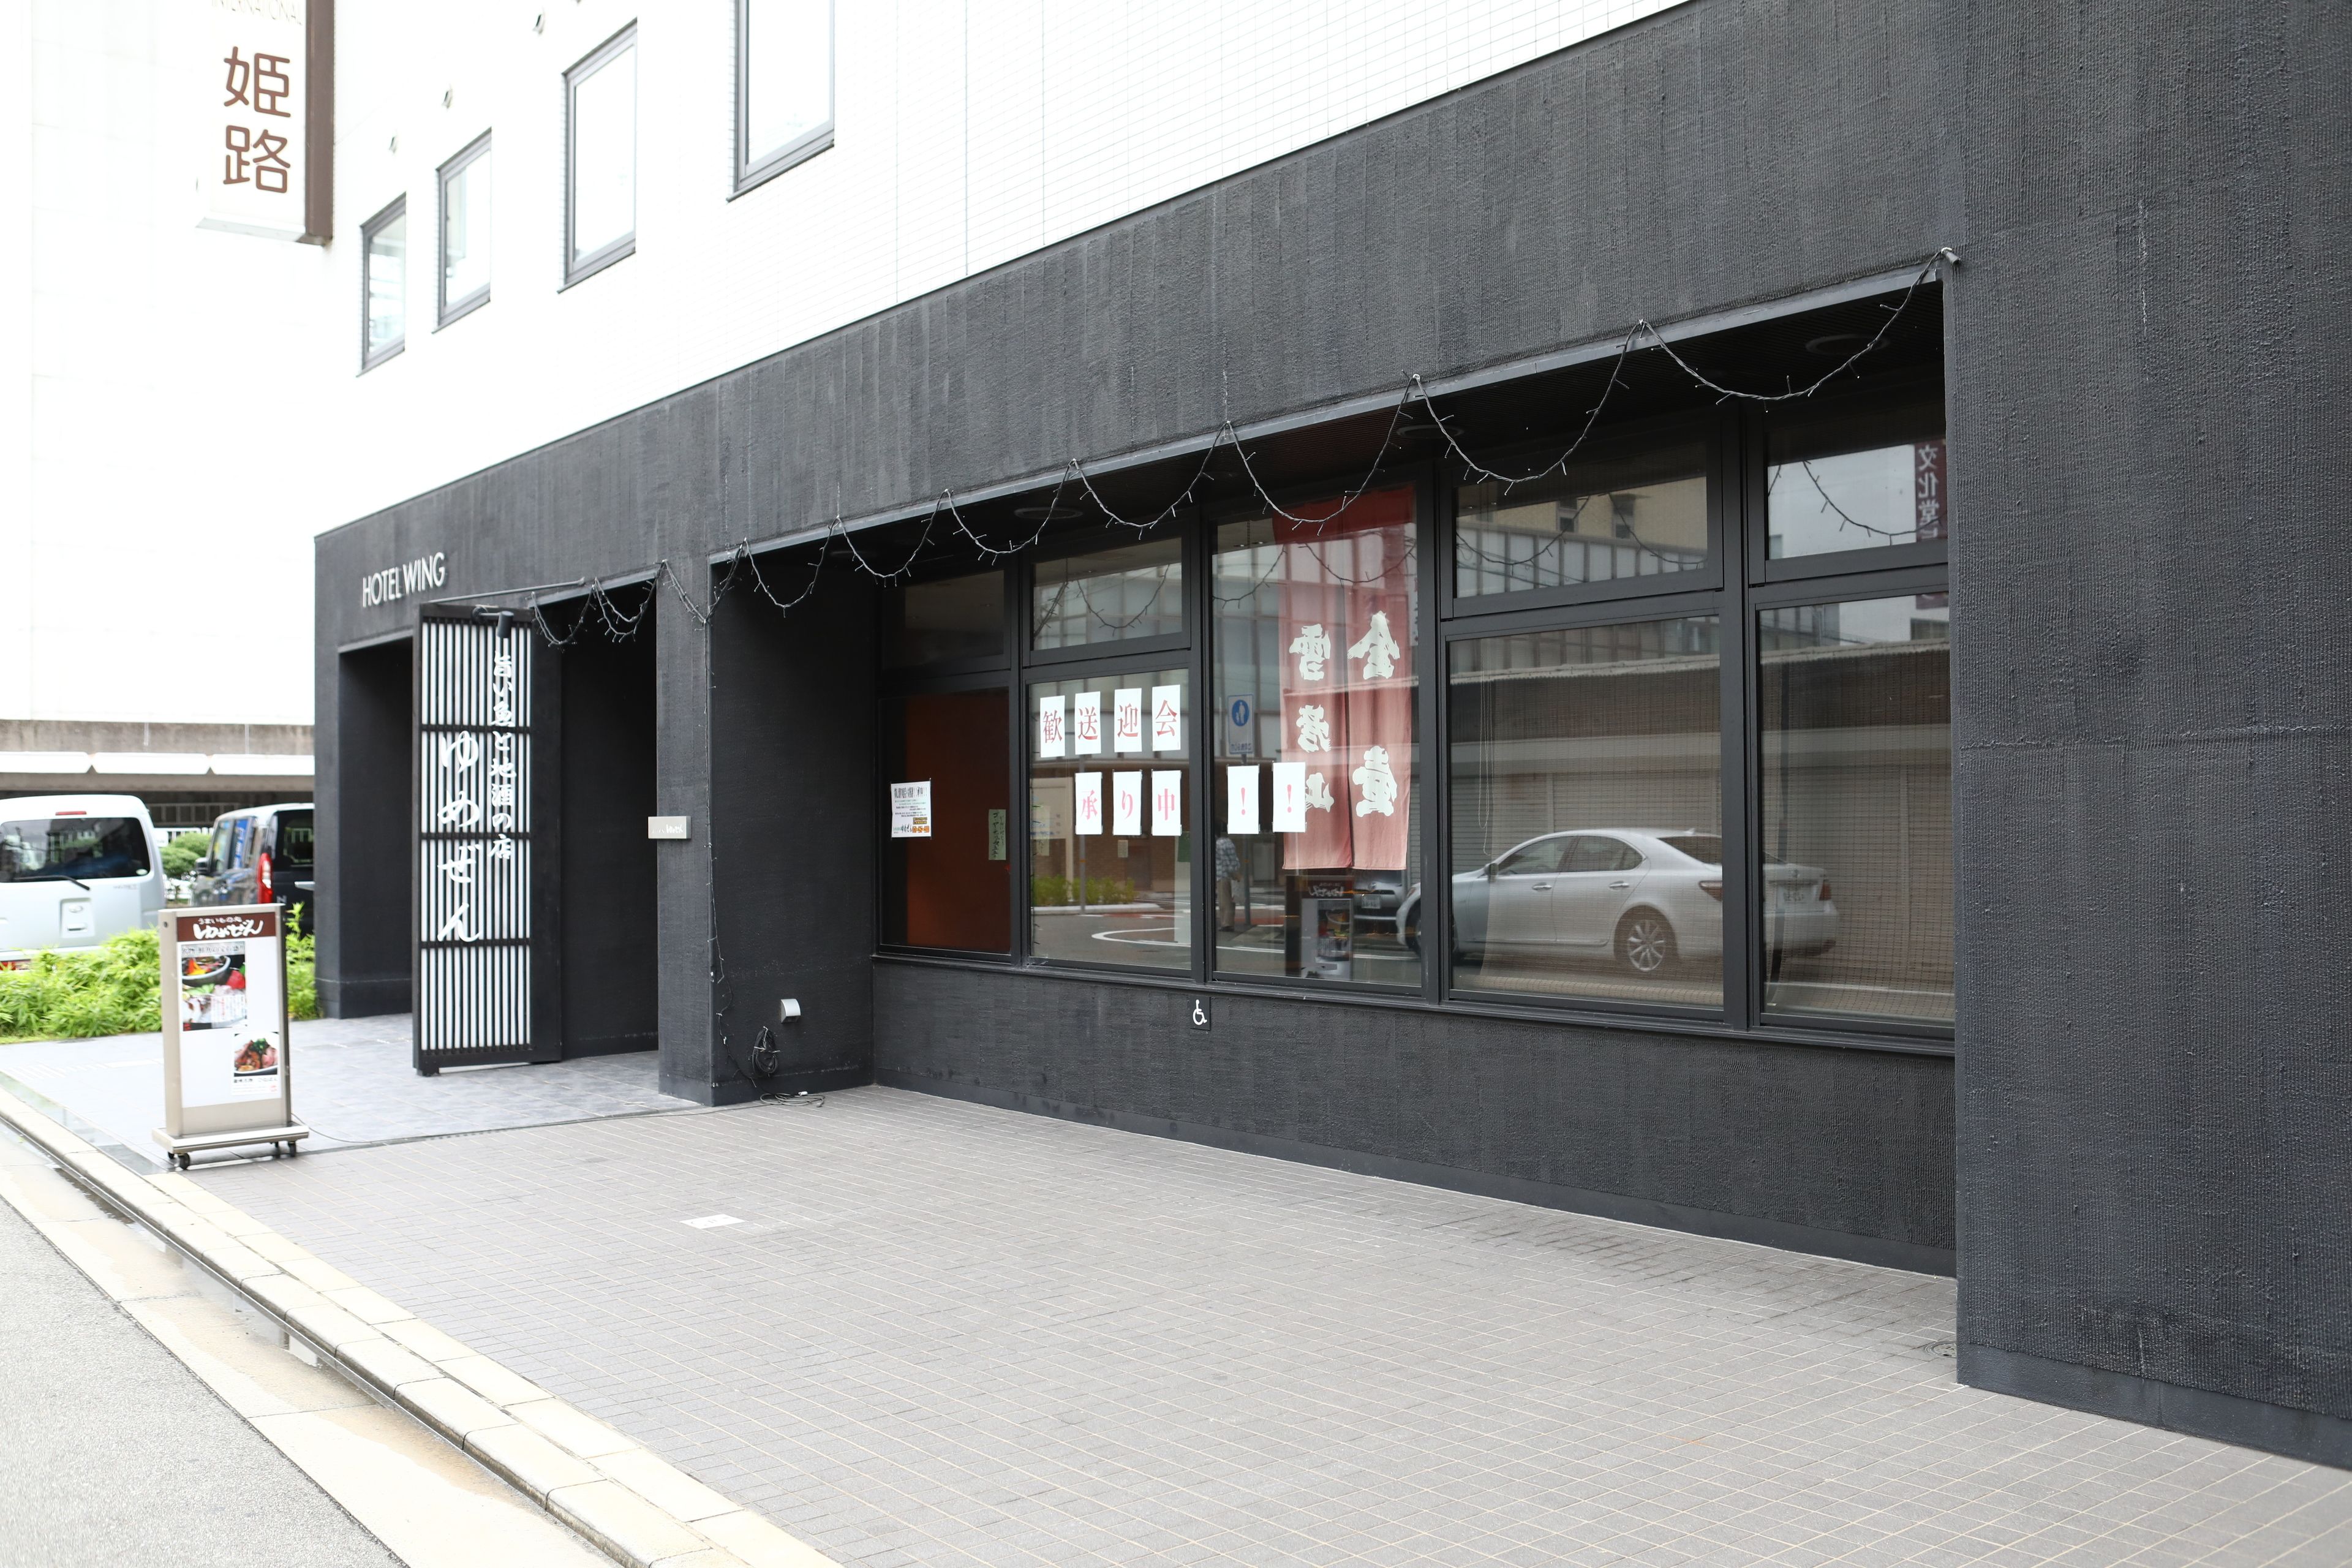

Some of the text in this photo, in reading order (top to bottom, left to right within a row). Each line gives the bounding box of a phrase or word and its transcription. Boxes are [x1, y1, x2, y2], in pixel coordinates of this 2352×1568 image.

[224, 46, 291, 194] 姫路
[363, 551, 446, 608] HOTEL WING
[489, 650, 517, 859] 旨い魚と地酒の店
[1042, 699, 1177, 744] 歓送迎会
[437, 729, 482, 943] ゆめぜん
[1080, 788, 1175, 821] 承り中
